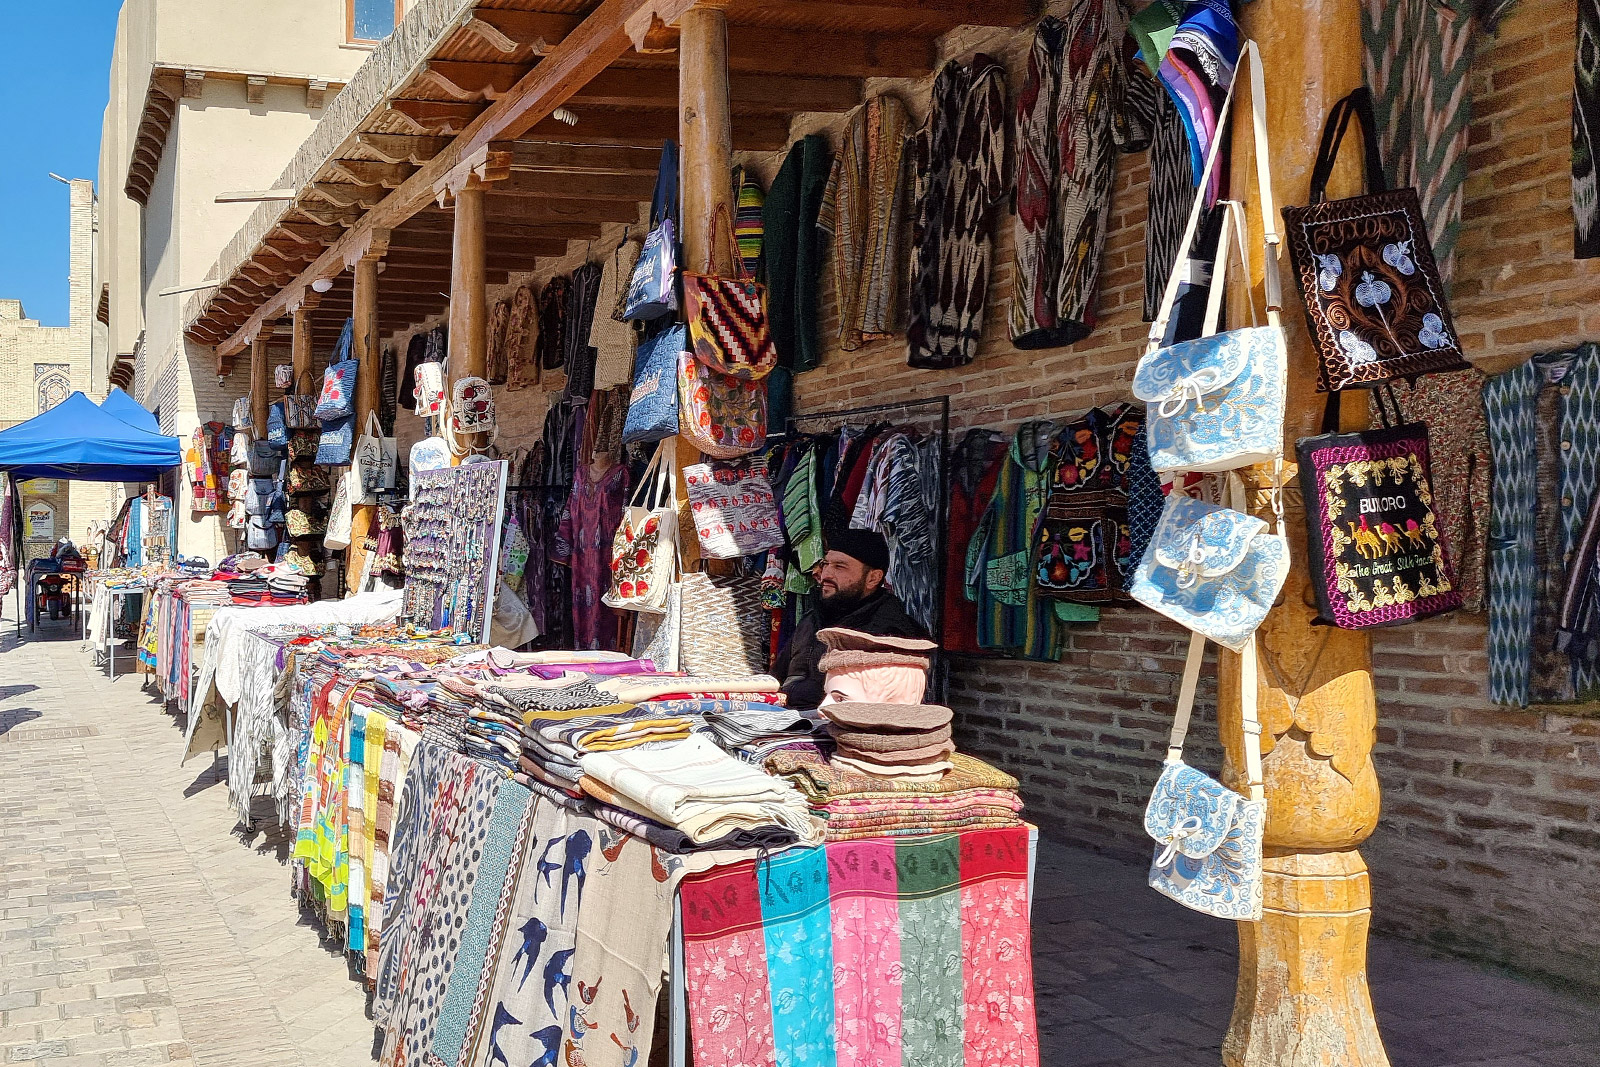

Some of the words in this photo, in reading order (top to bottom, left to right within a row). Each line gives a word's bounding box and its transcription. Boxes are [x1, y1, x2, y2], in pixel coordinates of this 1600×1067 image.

[1360, 495, 1406, 514] BUXORO
[1353, 563, 1370, 578] The
[1372, 561, 1393, 575] Great
